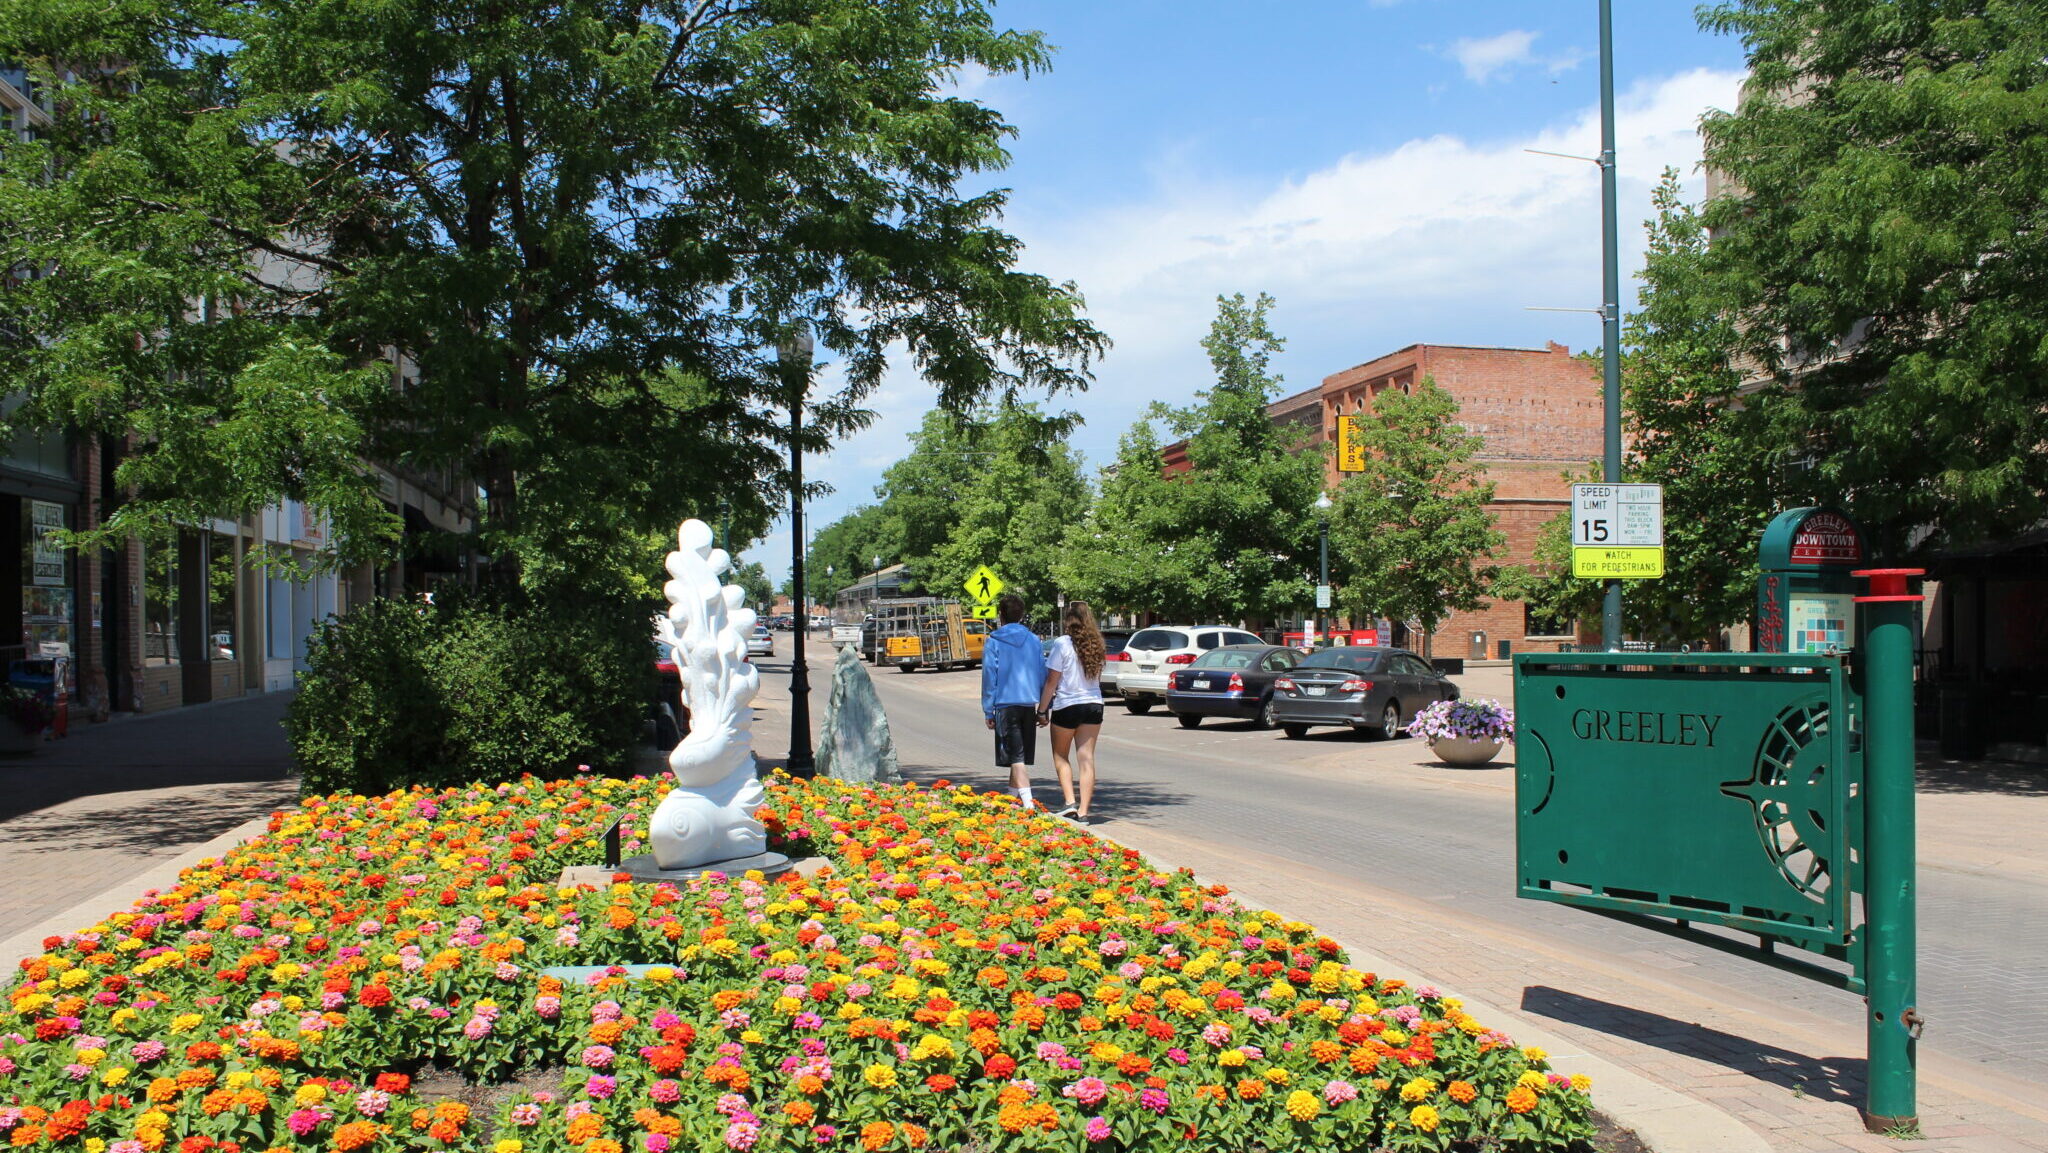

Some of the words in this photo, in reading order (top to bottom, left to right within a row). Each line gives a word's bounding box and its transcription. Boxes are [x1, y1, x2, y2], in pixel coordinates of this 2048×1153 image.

[1580, 487, 1611, 497] SPEED
[1583, 500, 1607, 510] LIMIT
[1803, 513, 1849, 533] GREELEY
[1582, 519, 1609, 542] 15
[1795, 533, 1855, 546] DOWNTOWN
[1604, 551, 1632, 560] WATCH
[1581, 562, 1597, 571] FOR
[1601, 562, 1656, 572] PEDESTRIANS
[1571, 708, 1723, 748] GREELEY
